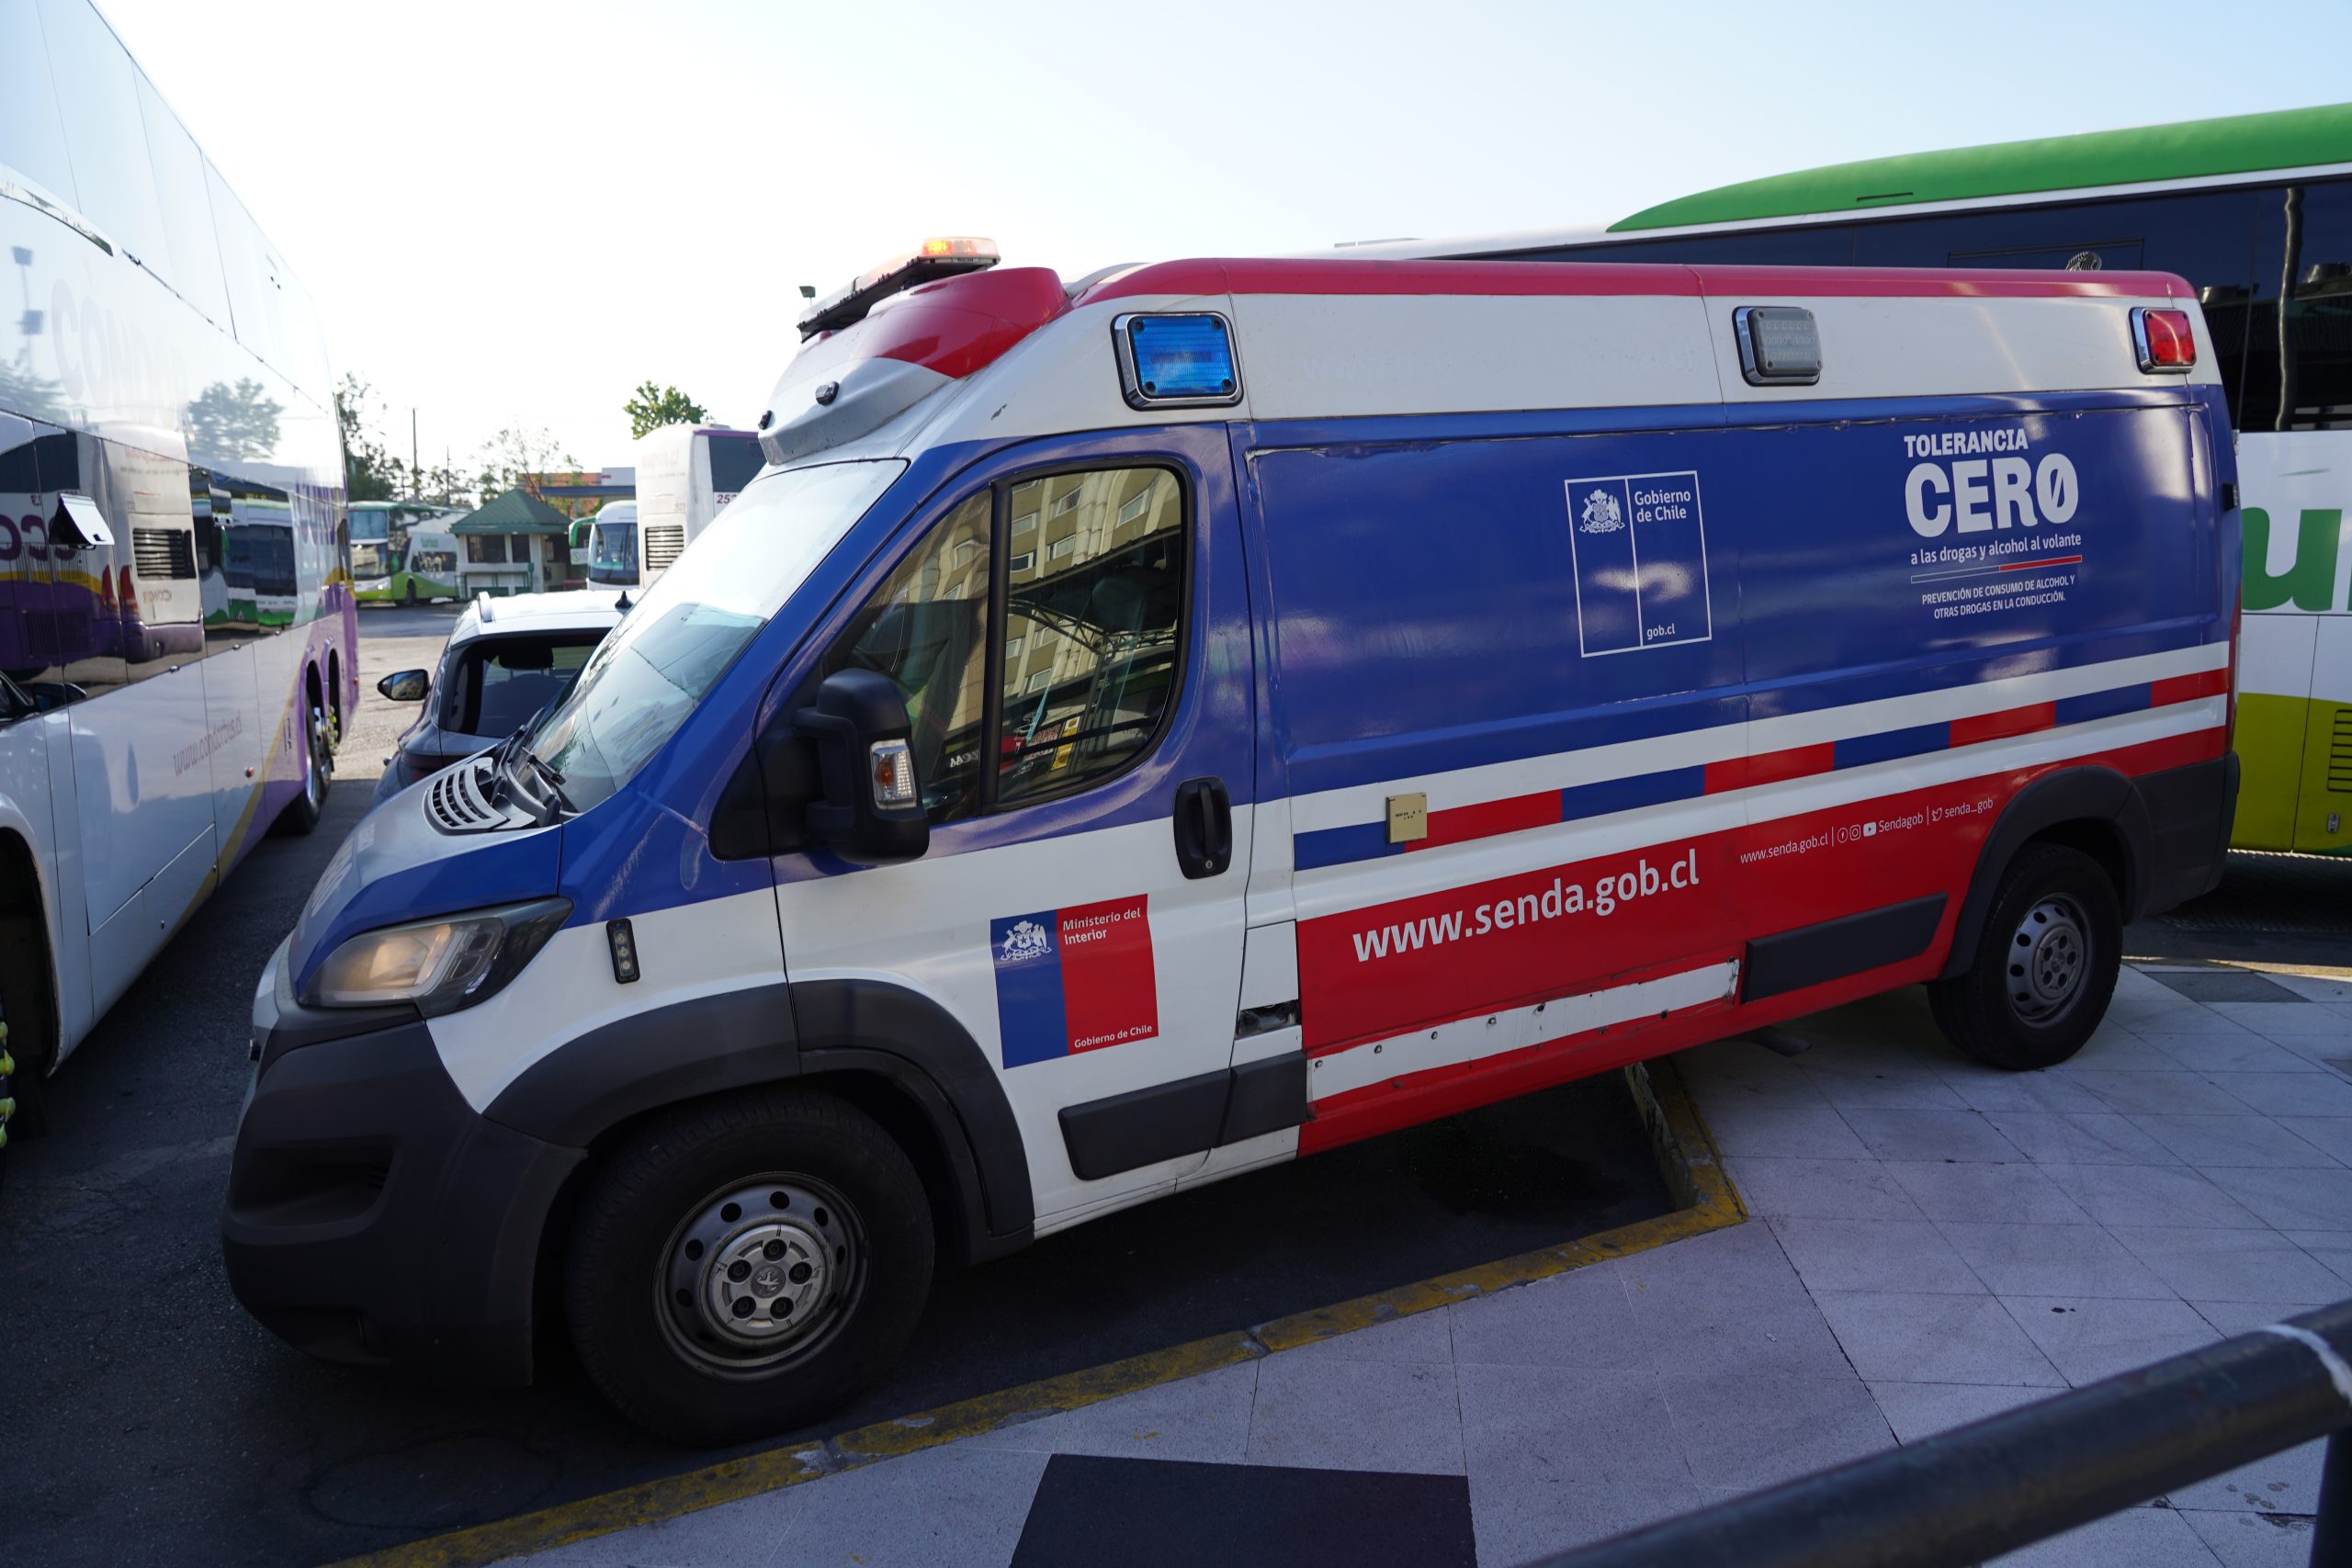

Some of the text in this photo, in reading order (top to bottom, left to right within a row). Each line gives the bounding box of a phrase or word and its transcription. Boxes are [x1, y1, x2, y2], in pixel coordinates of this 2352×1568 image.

[1904, 428, 2029, 457] TOLERANCIA
[1634, 490, 1691, 506] Gobierno
[1636, 505, 1687, 523] de Chile
[1911, 533, 2082, 565] a las drogas y alcohol al volante
[1922, 574, 2075, 604] PREVENCIÓN DE CONSUMO DE ALCOHOL Y
[1934, 590, 2066, 619] OTRAS DROGAS EN LA CONDUCCIÓN.
[1646, 623, 1676, 640] gob.cl
[1740, 797, 1994, 864] www.senda.gob.cl Sendagob senda_gob
[1352, 848, 1700, 963] www.senda.gob.cl
[1063, 908, 1141, 931] Ministerio del
[1064, 929, 1107, 945] Interior
[1074, 1024, 1152, 1048] Gobierno de Chile
